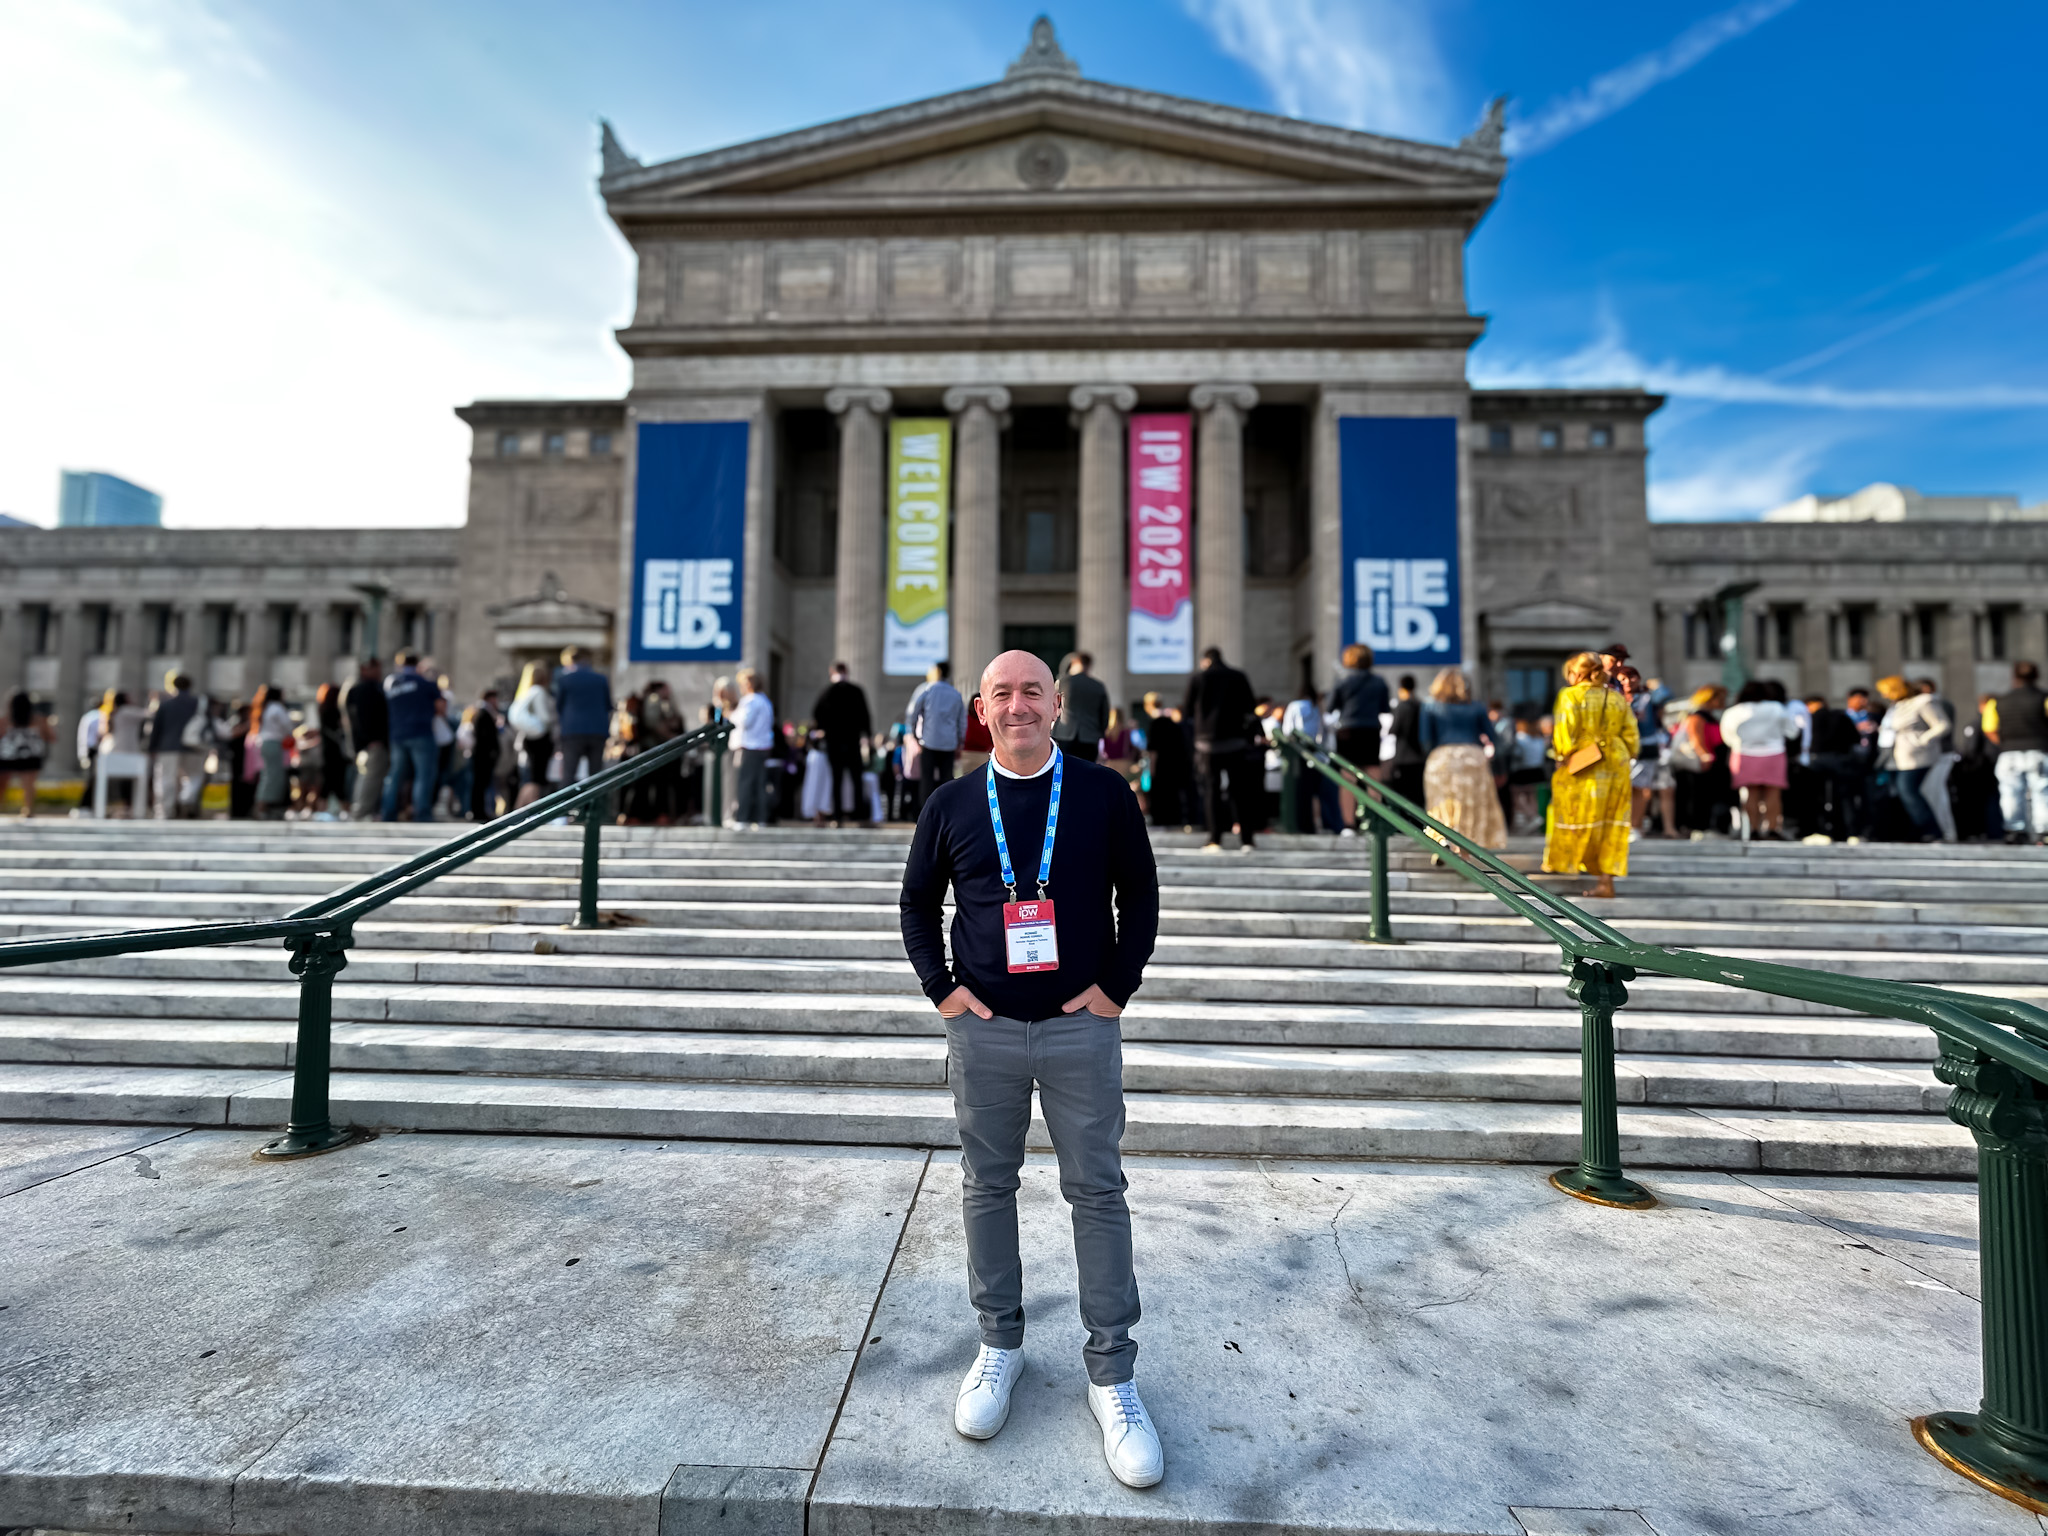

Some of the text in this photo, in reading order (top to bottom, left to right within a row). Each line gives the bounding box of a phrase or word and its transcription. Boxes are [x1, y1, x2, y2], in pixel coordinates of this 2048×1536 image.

[1139, 430, 1182, 492] IPW
[896, 433, 941, 592] WELCOME
[1138, 505, 1182, 587] 2025
